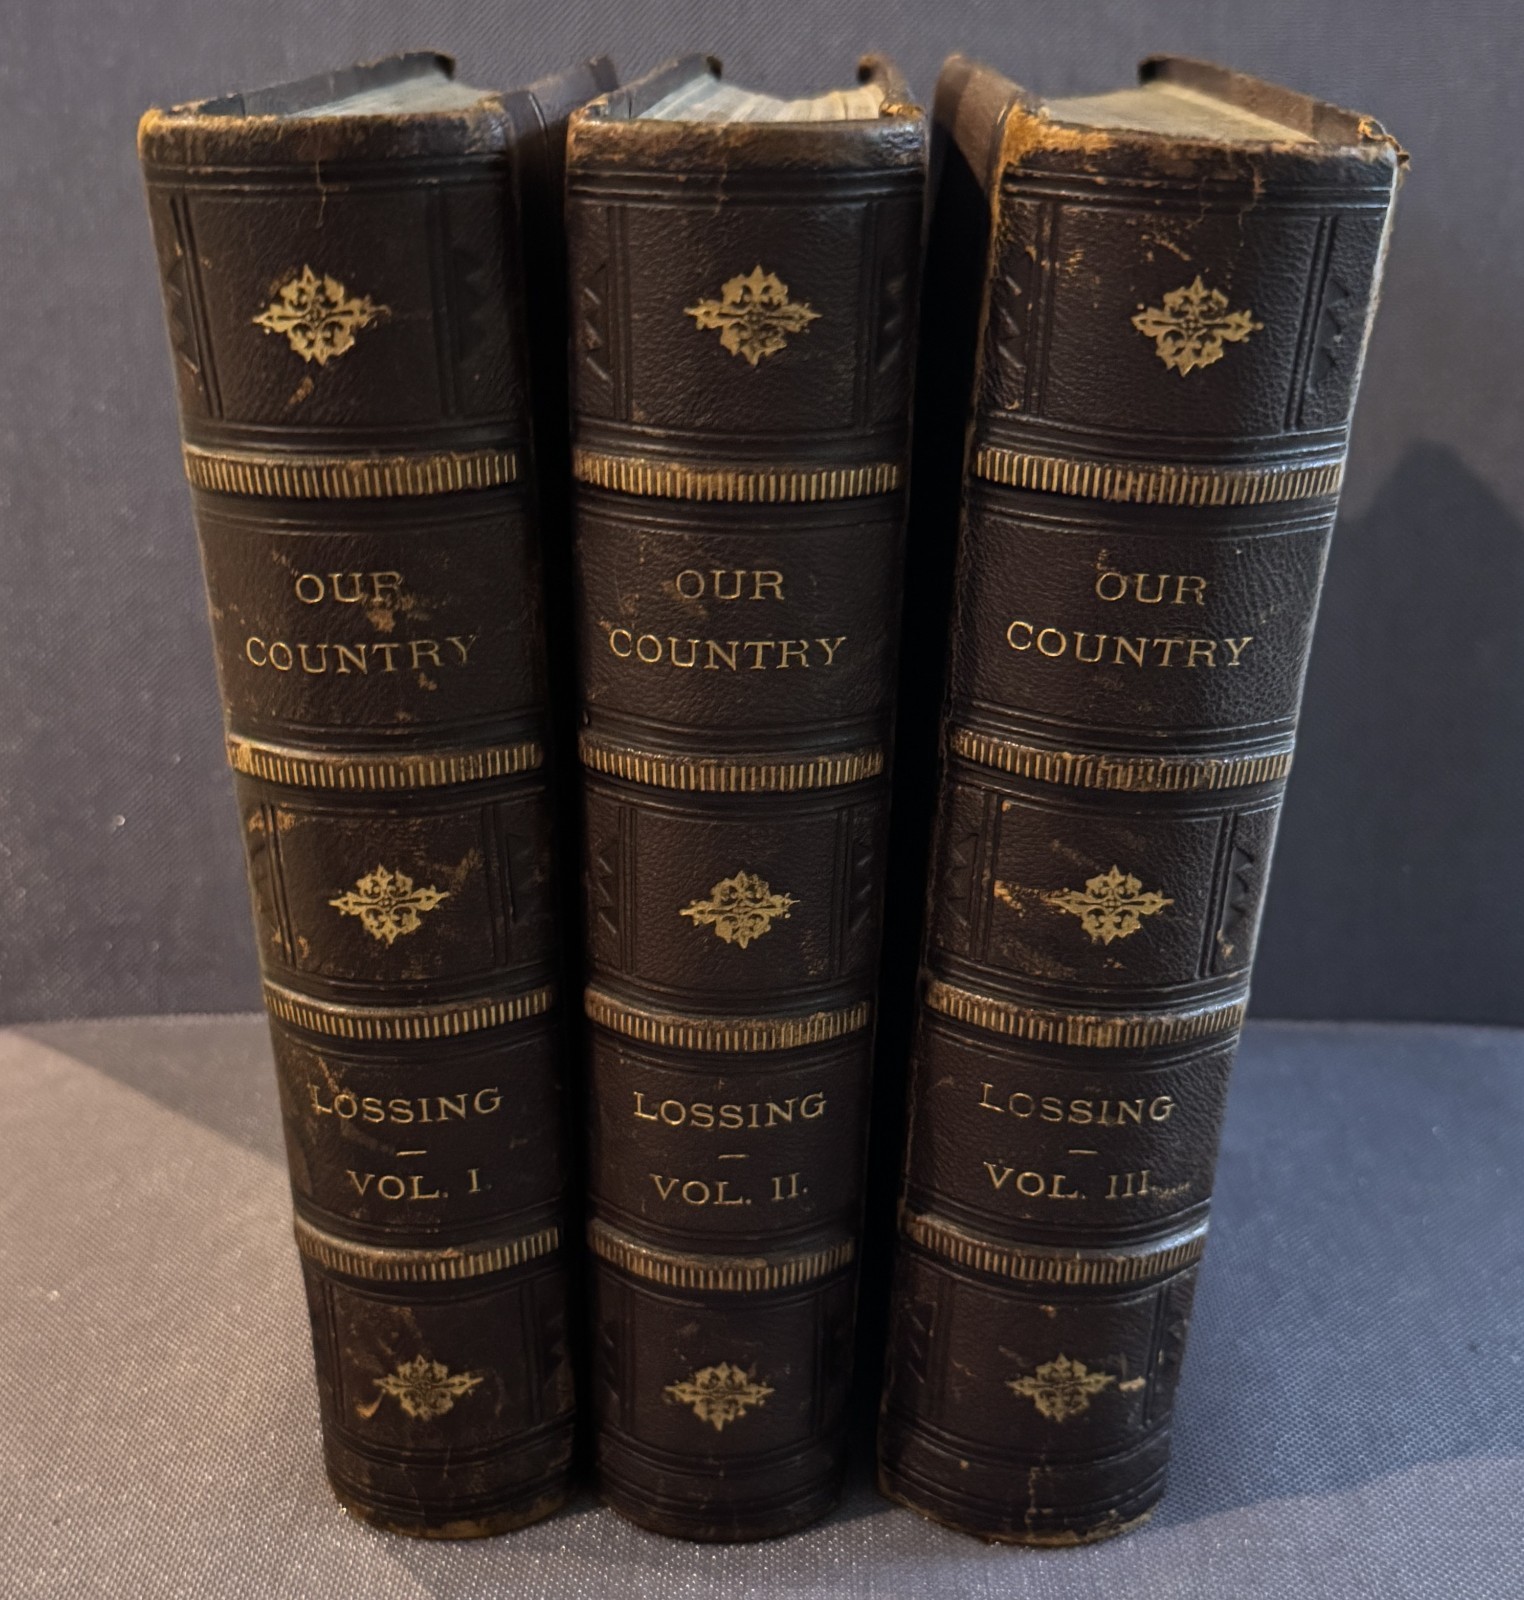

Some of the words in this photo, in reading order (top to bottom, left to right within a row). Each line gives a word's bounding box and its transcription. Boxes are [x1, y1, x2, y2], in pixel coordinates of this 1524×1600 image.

[295, 571, 403, 604] OUR
[676, 569, 786, 601] OUR
[1095, 571, 1208, 606] OUR
[246, 634, 478, 675] COUNTRY
[609, 628, 847, 671] COUNTRY
[1006, 620, 1254, 668] COUNTRY
[308, 1086, 504, 1124] LOSSING
[633, 1090, 827, 1129] LOSSING
[977, 1081, 1176, 1125] LOSSING
[346, 1169, 449, 1200] VOL.
[649, 1172, 751, 1205] VOL.
[771, 1172, 809, 1201] II.
[983, 1161, 1086, 1199] VOL.
